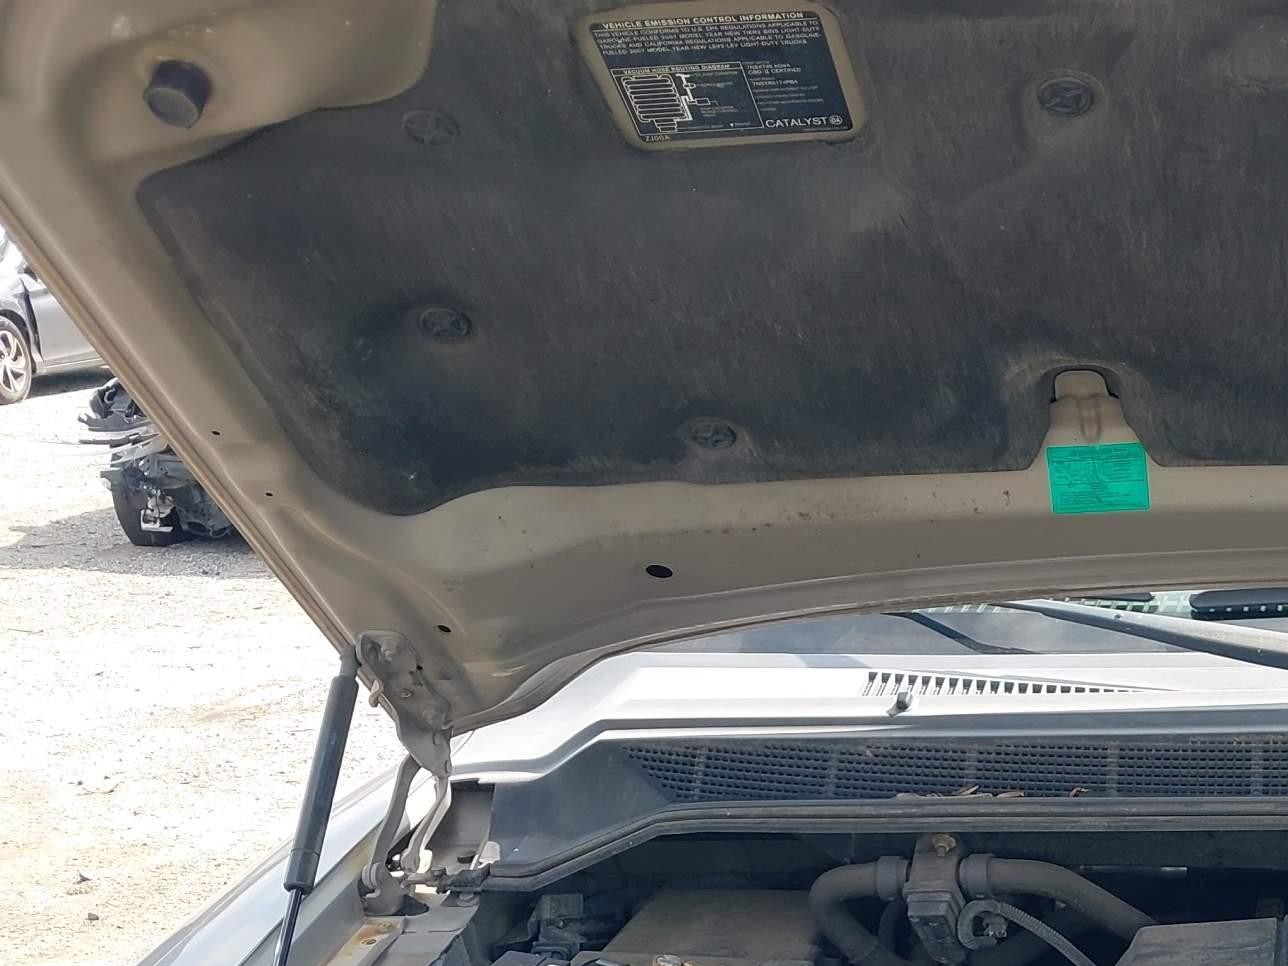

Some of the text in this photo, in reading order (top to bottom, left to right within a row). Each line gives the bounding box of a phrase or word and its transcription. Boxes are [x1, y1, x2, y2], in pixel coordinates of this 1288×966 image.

[602, 12, 804, 30] VEHICLE EMISSION CONTROL INFORMATION
[640, 28, 679, 36] CONFORMS
[720, 23, 765, 31] REGULATIONS
[644, 39, 683, 47] CALIFORNIA
[685, 37, 731, 45] REGULATIONS
[602, 48, 628, 56] FUELED
[623, 68, 651, 76] VACUUM
[701, 63, 730, 71] DIAGRAM
[765, 116, 828, 128] CATALYST
